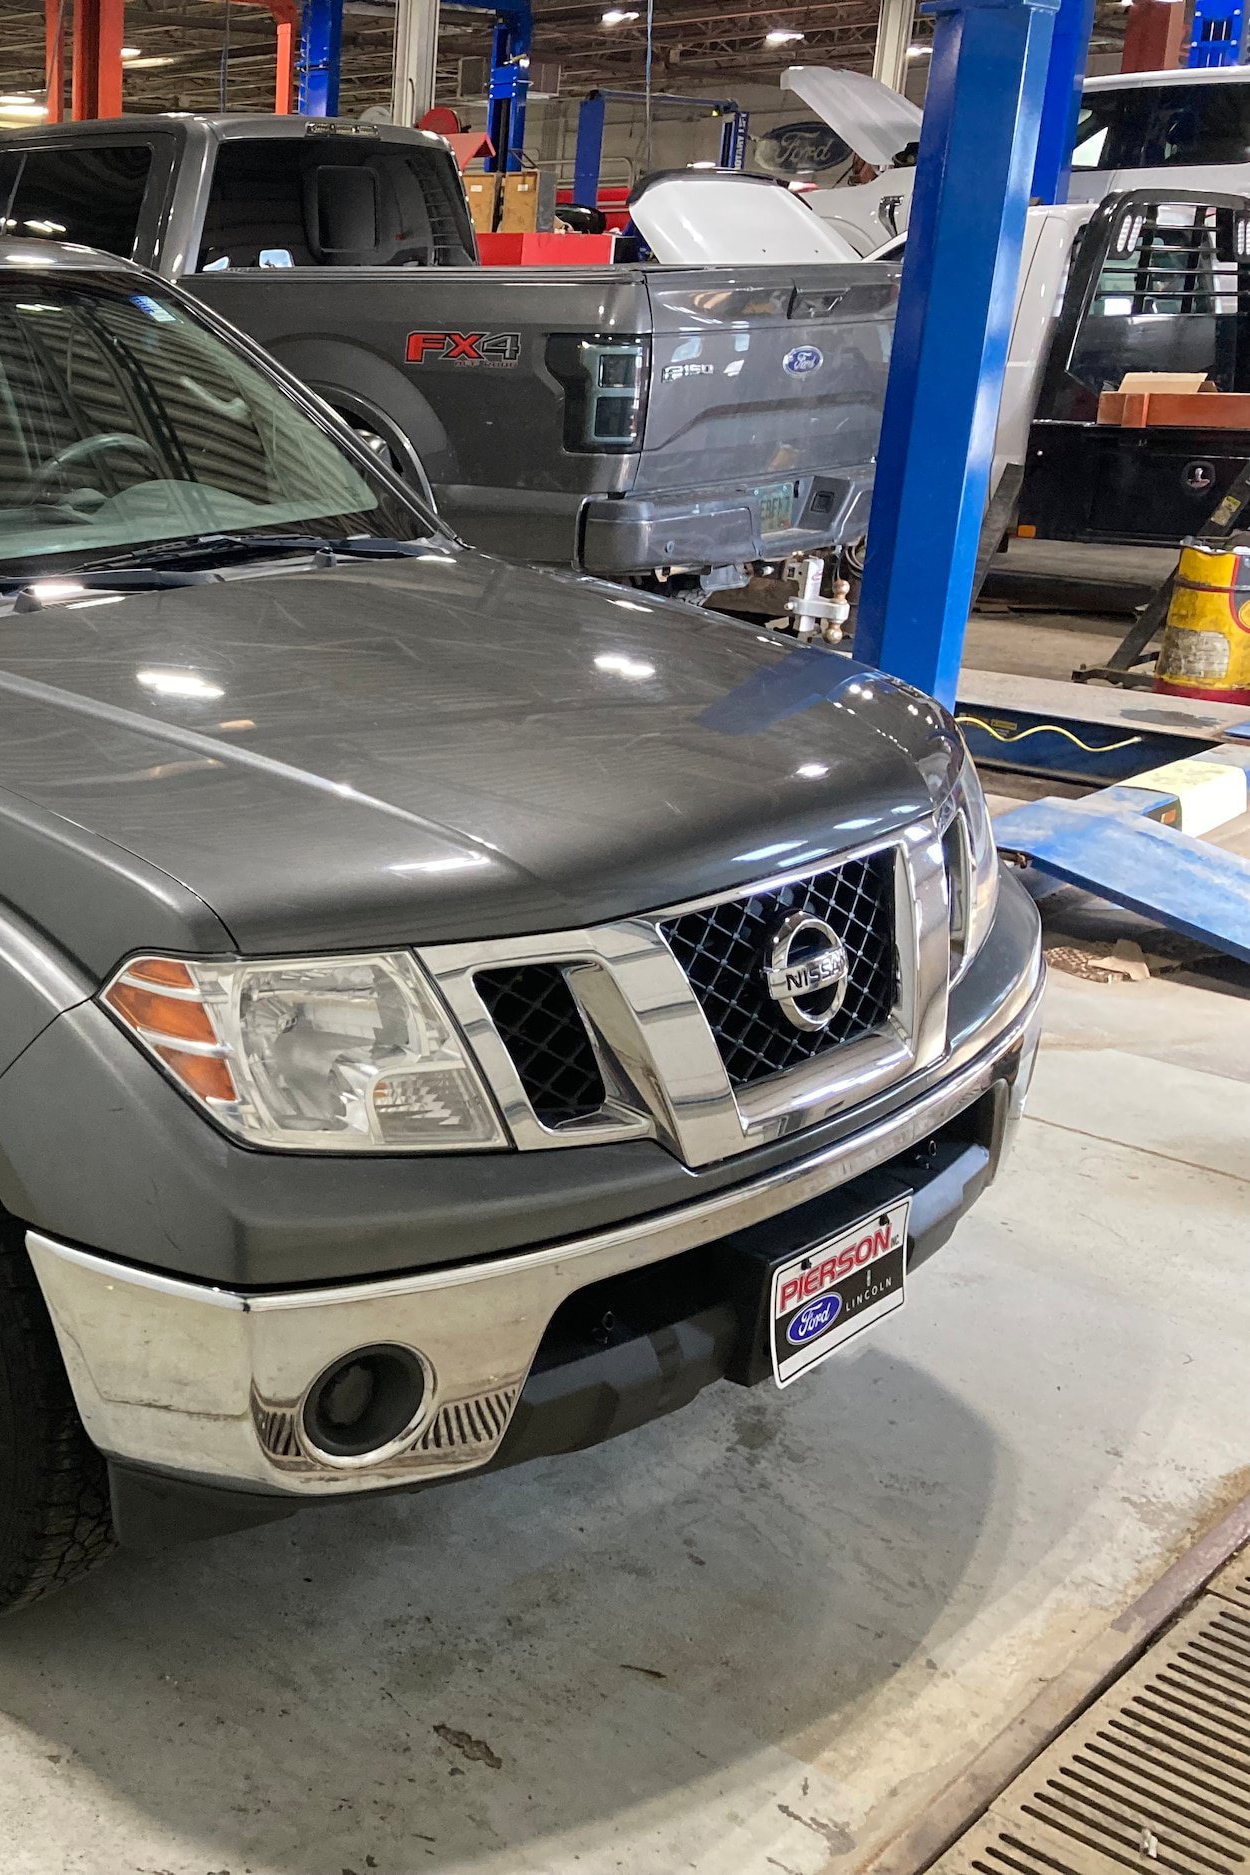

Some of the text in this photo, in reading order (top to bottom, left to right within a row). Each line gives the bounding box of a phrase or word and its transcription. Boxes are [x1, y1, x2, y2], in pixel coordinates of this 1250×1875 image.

[776, 131, 834, 162] Ford
[405, 330, 522, 365] FX4
[779, 1221, 893, 1314] PIERSON
[845, 1276, 892, 1312] LINCOLN
